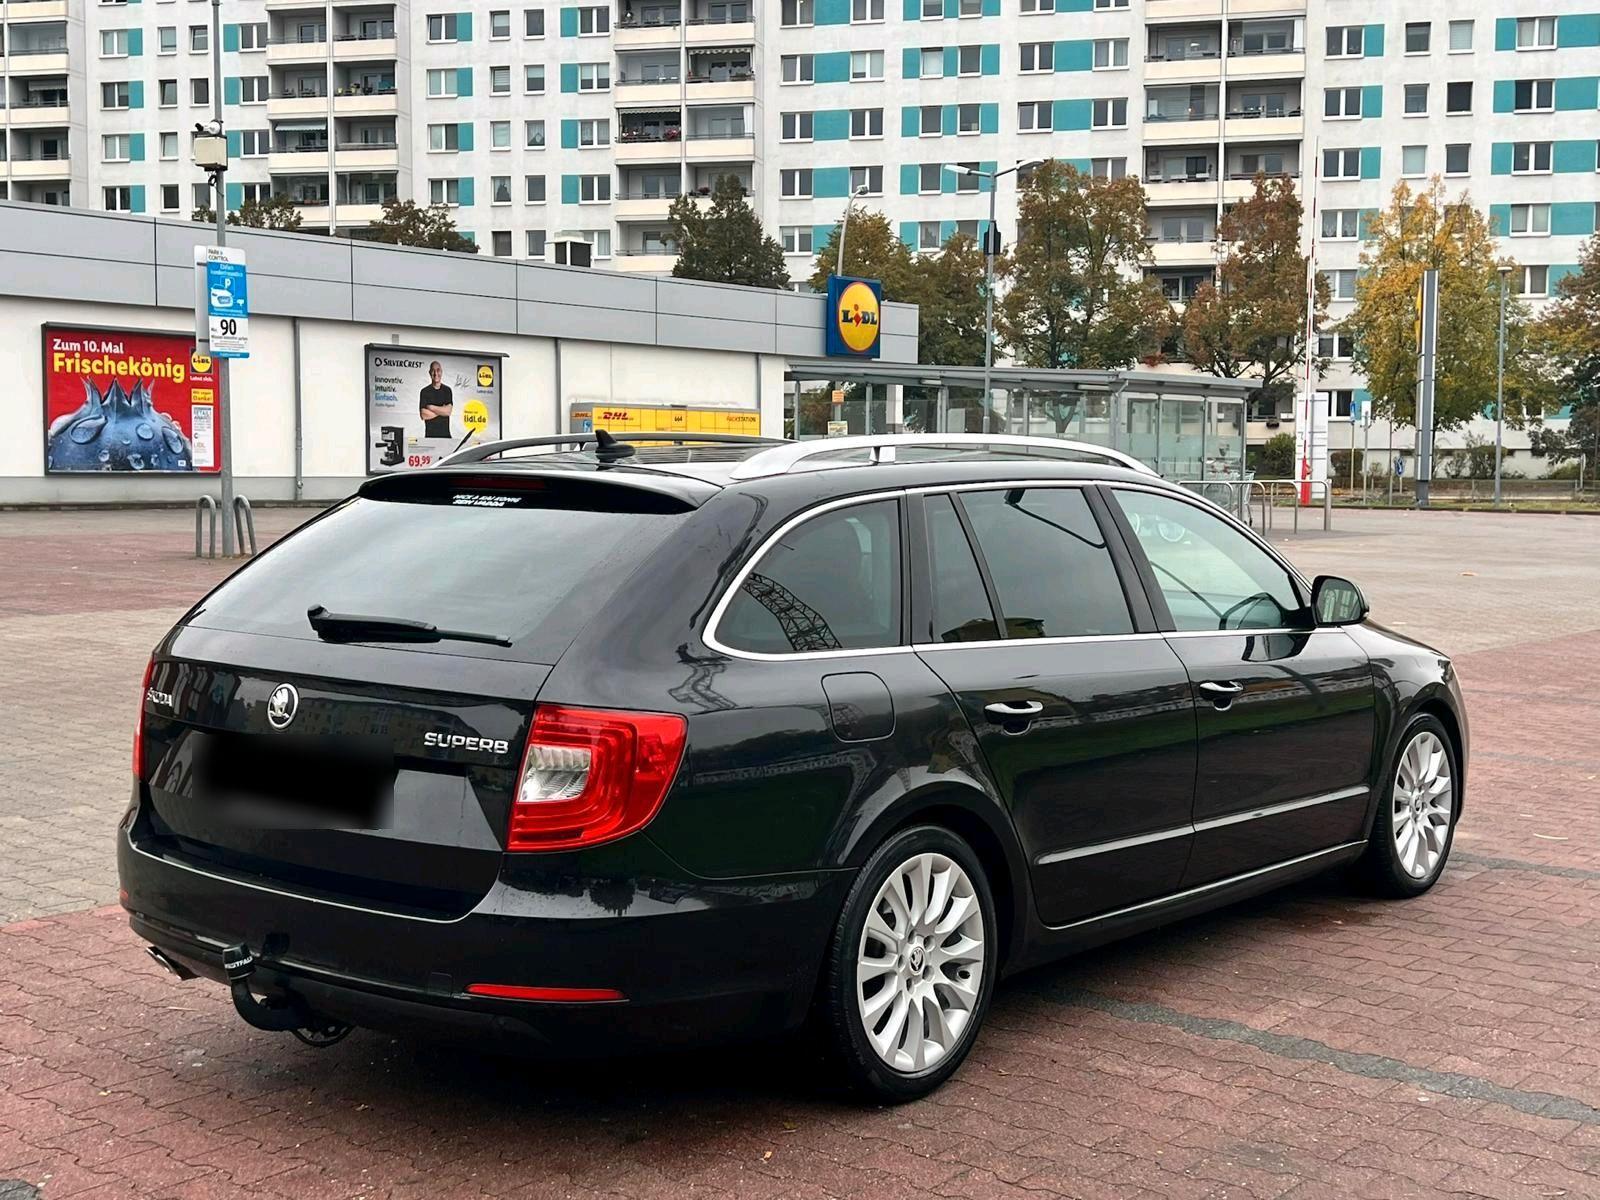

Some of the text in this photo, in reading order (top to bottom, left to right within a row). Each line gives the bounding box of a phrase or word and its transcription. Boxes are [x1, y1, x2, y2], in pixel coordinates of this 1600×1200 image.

[220, 318, 237, 336] 90
[53, 338, 124, 354] Zum 10. Mal
[53, 352, 185, 383] Frischekönig
[603, 411, 629, 421] DHL
[424, 732, 509, 754] SUPERB
